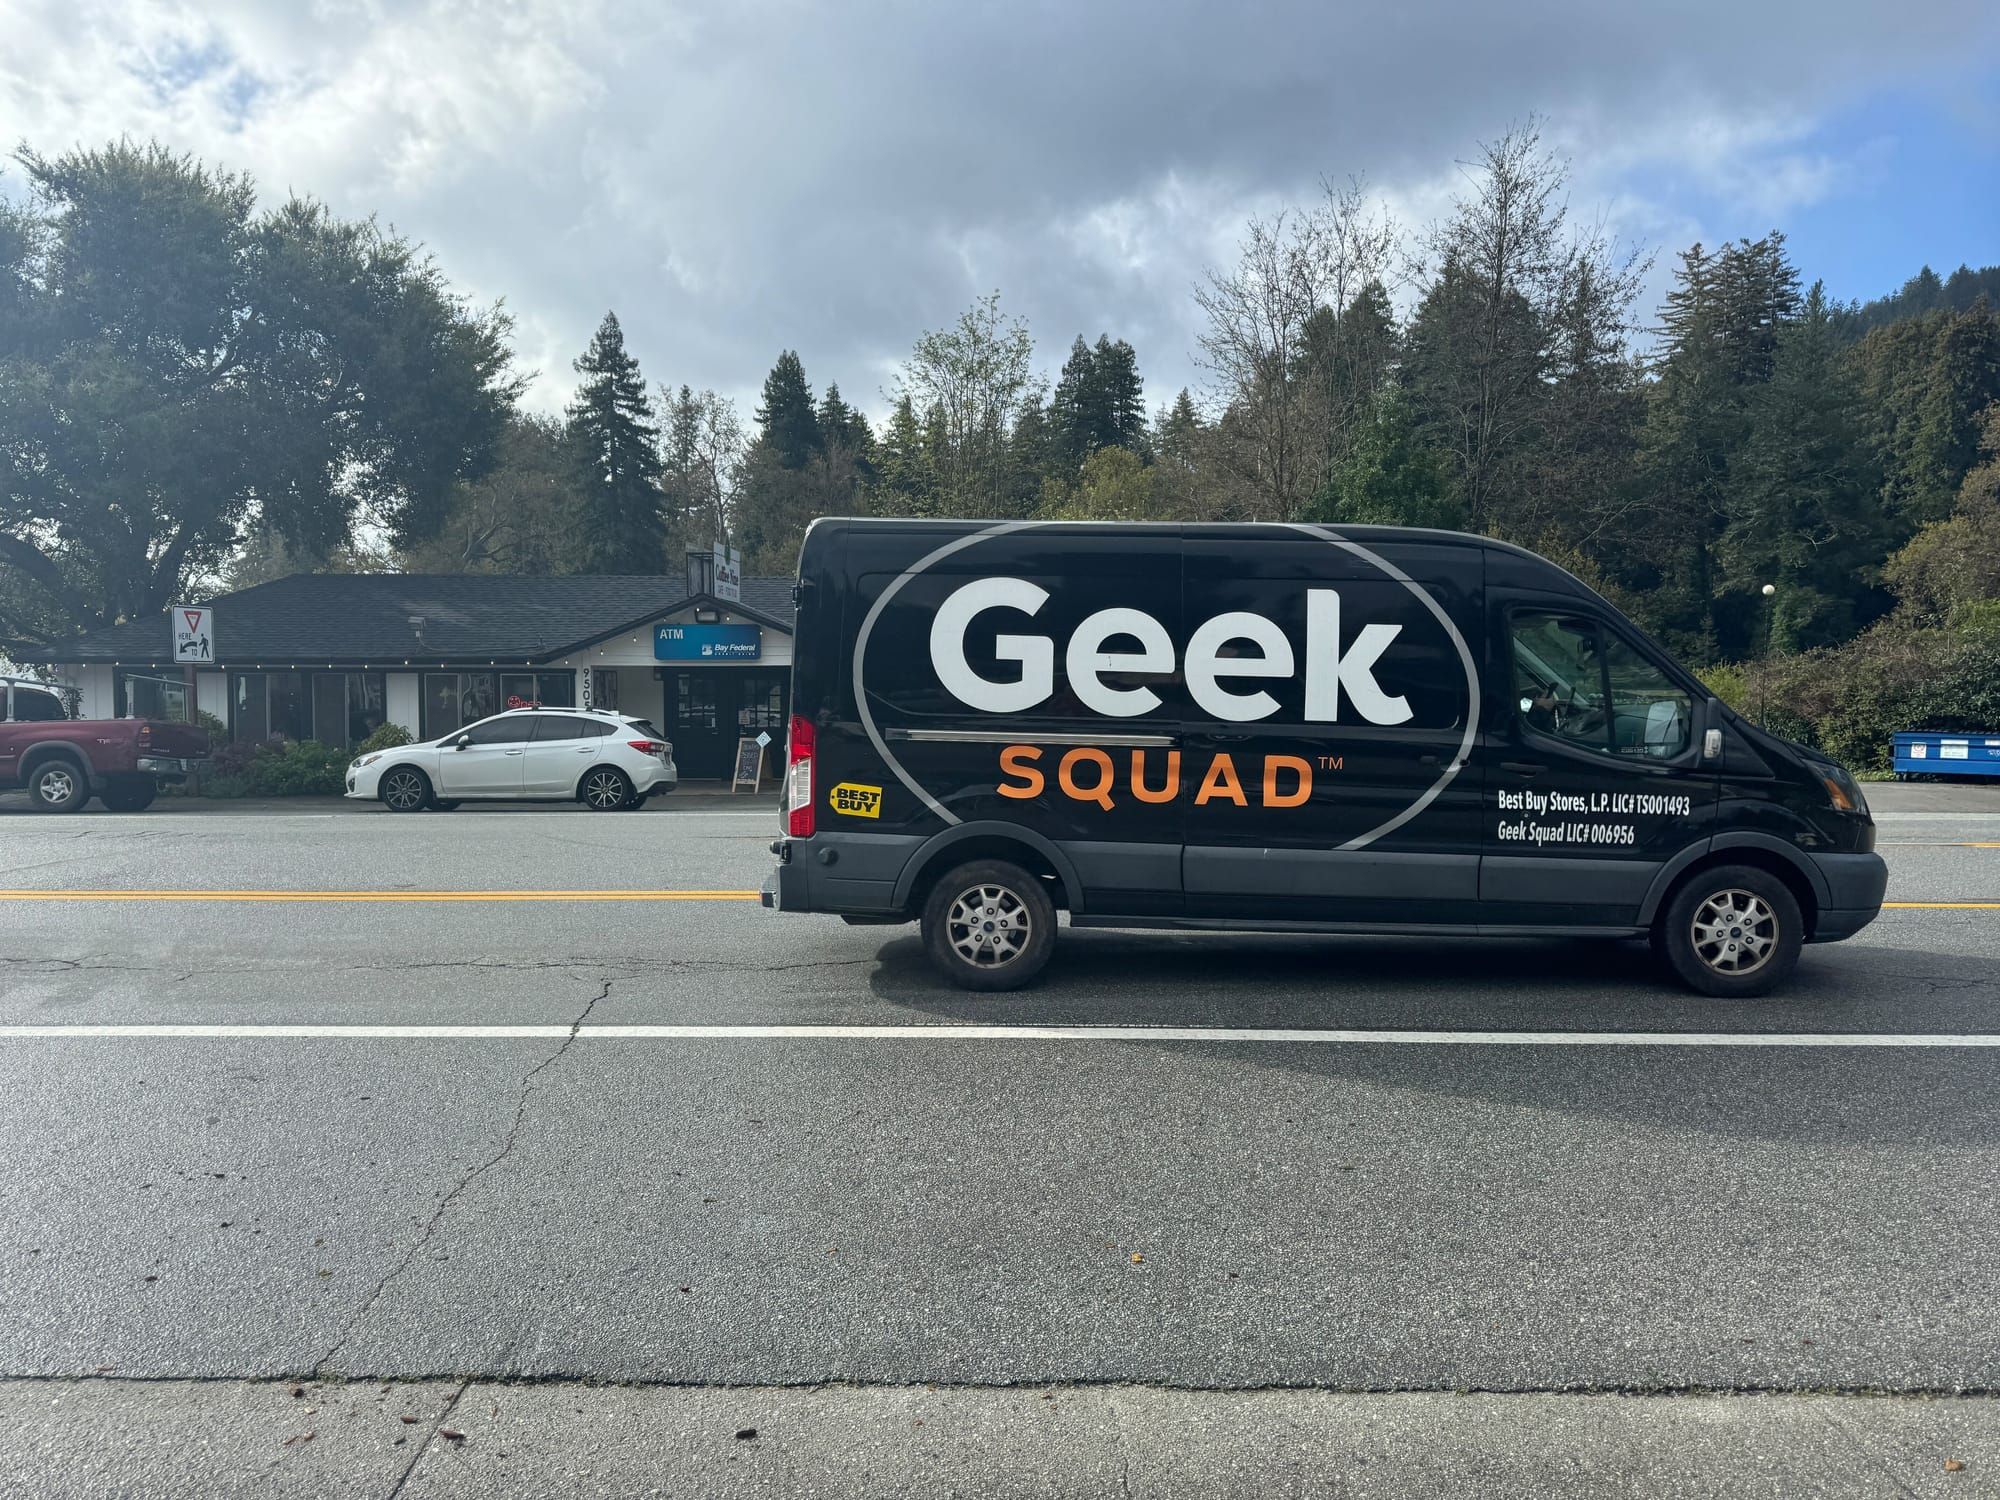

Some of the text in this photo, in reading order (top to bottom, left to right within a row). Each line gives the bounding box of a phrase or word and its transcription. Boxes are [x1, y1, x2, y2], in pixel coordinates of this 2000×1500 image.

[178, 632, 192, 640] HERE
[660, 629, 684, 640] ATM
[191, 648, 198, 657] TO
[714, 643, 756, 652] Bay Federal
[929, 576, 1414, 726] Geek
[996, 745, 1314, 812] SQUAD
[837, 788, 880, 803] BEST
[838, 799, 876, 813] BUY
[1498, 790, 1690, 816] Best Buy Stores, L.P. LIC# TS001493
[1498, 820, 1635, 847] Geek Squad LIC# 006956
